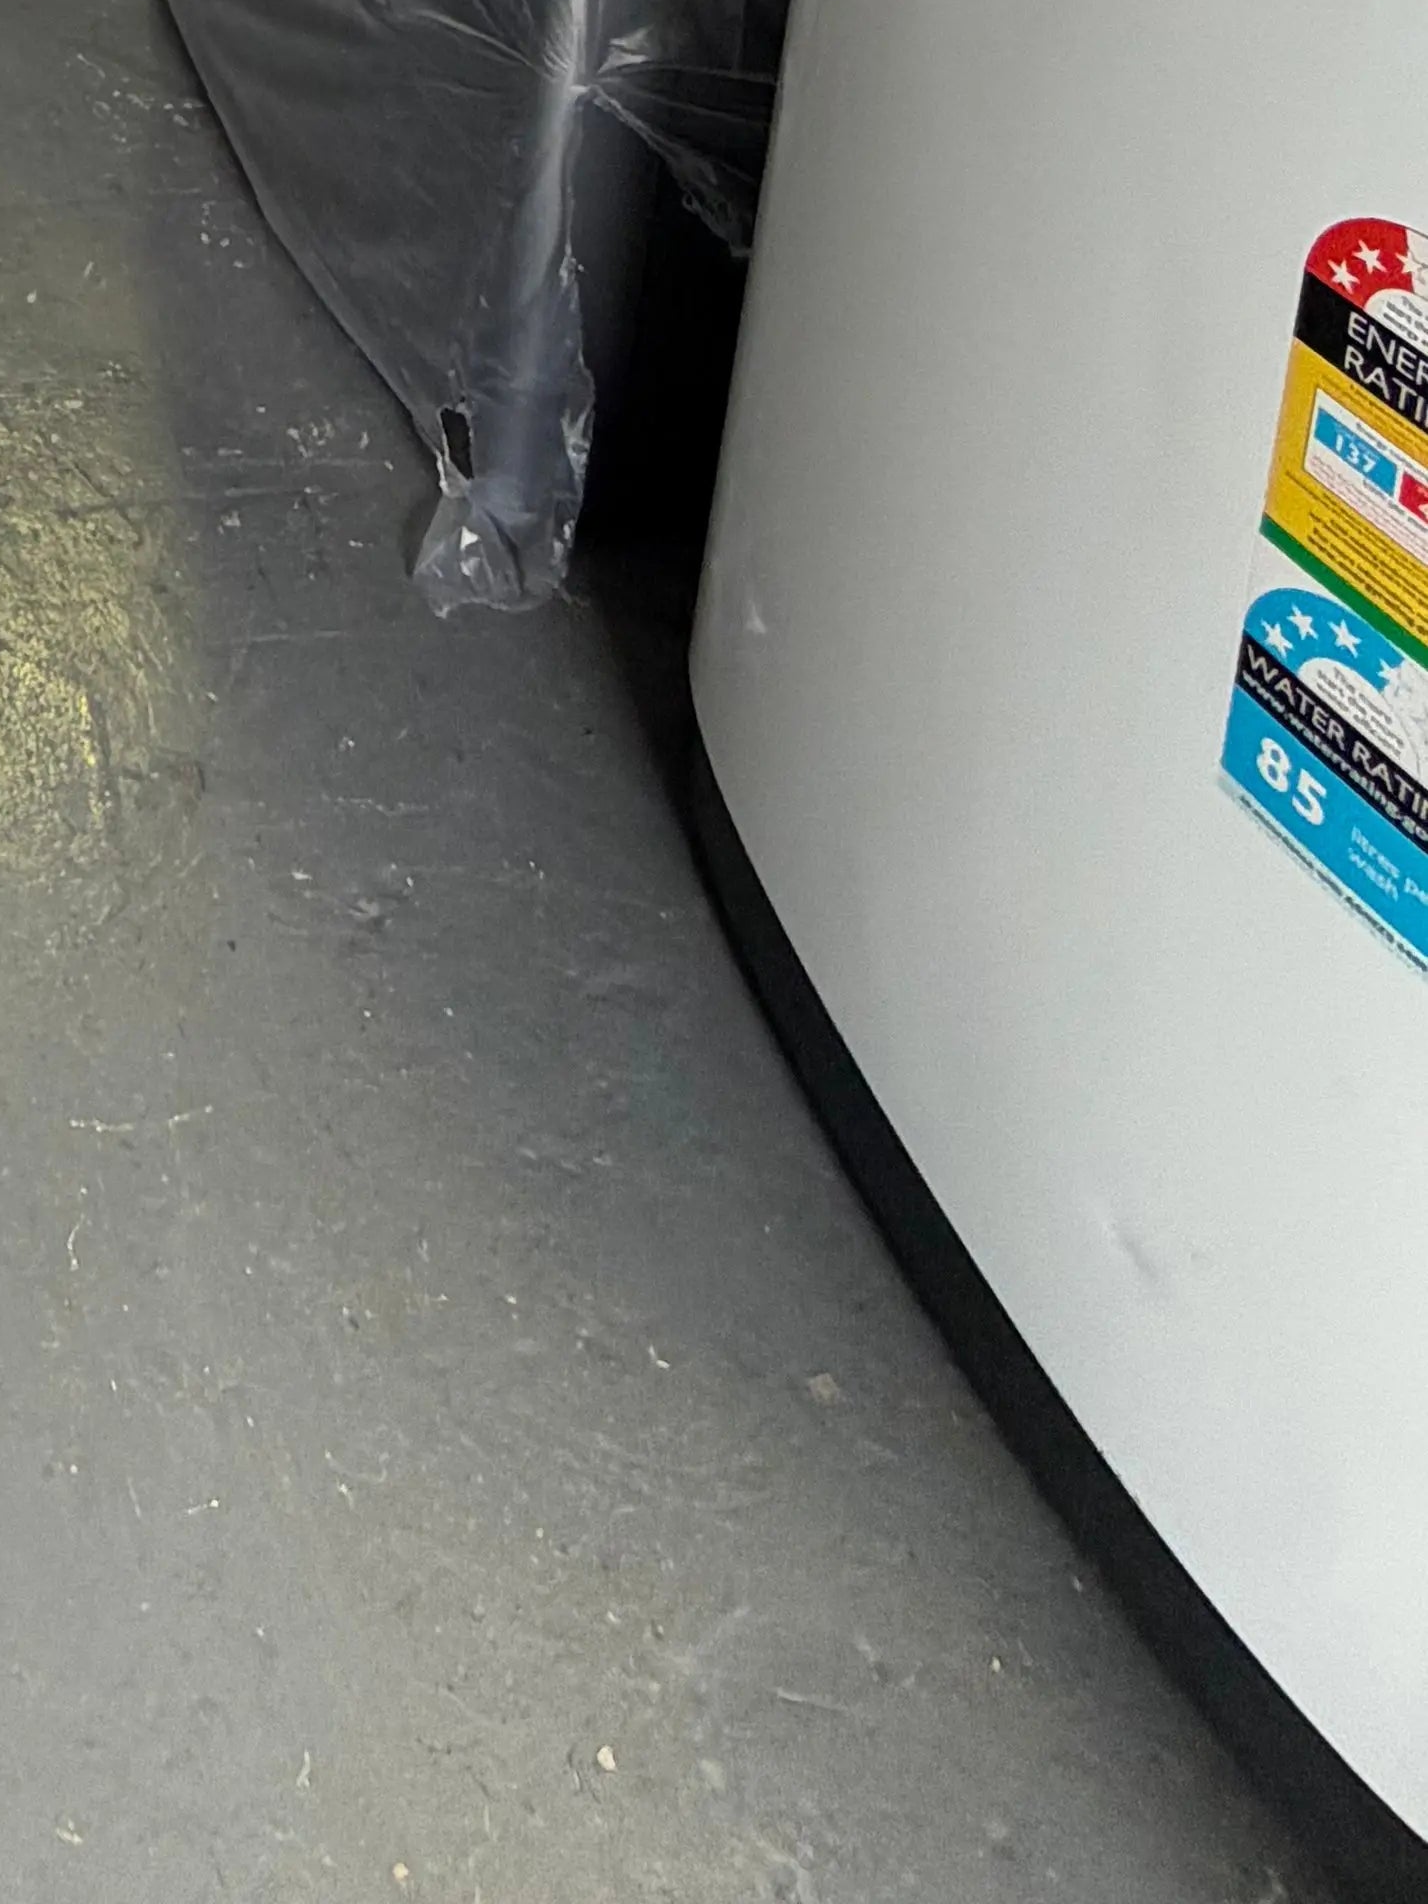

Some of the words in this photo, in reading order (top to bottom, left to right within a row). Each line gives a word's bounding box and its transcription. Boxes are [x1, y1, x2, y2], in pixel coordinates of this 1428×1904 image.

[1335, 433, 1377, 474] 137
[1247, 643, 1346, 752] WATER
[1255, 736, 1328, 826] 85
